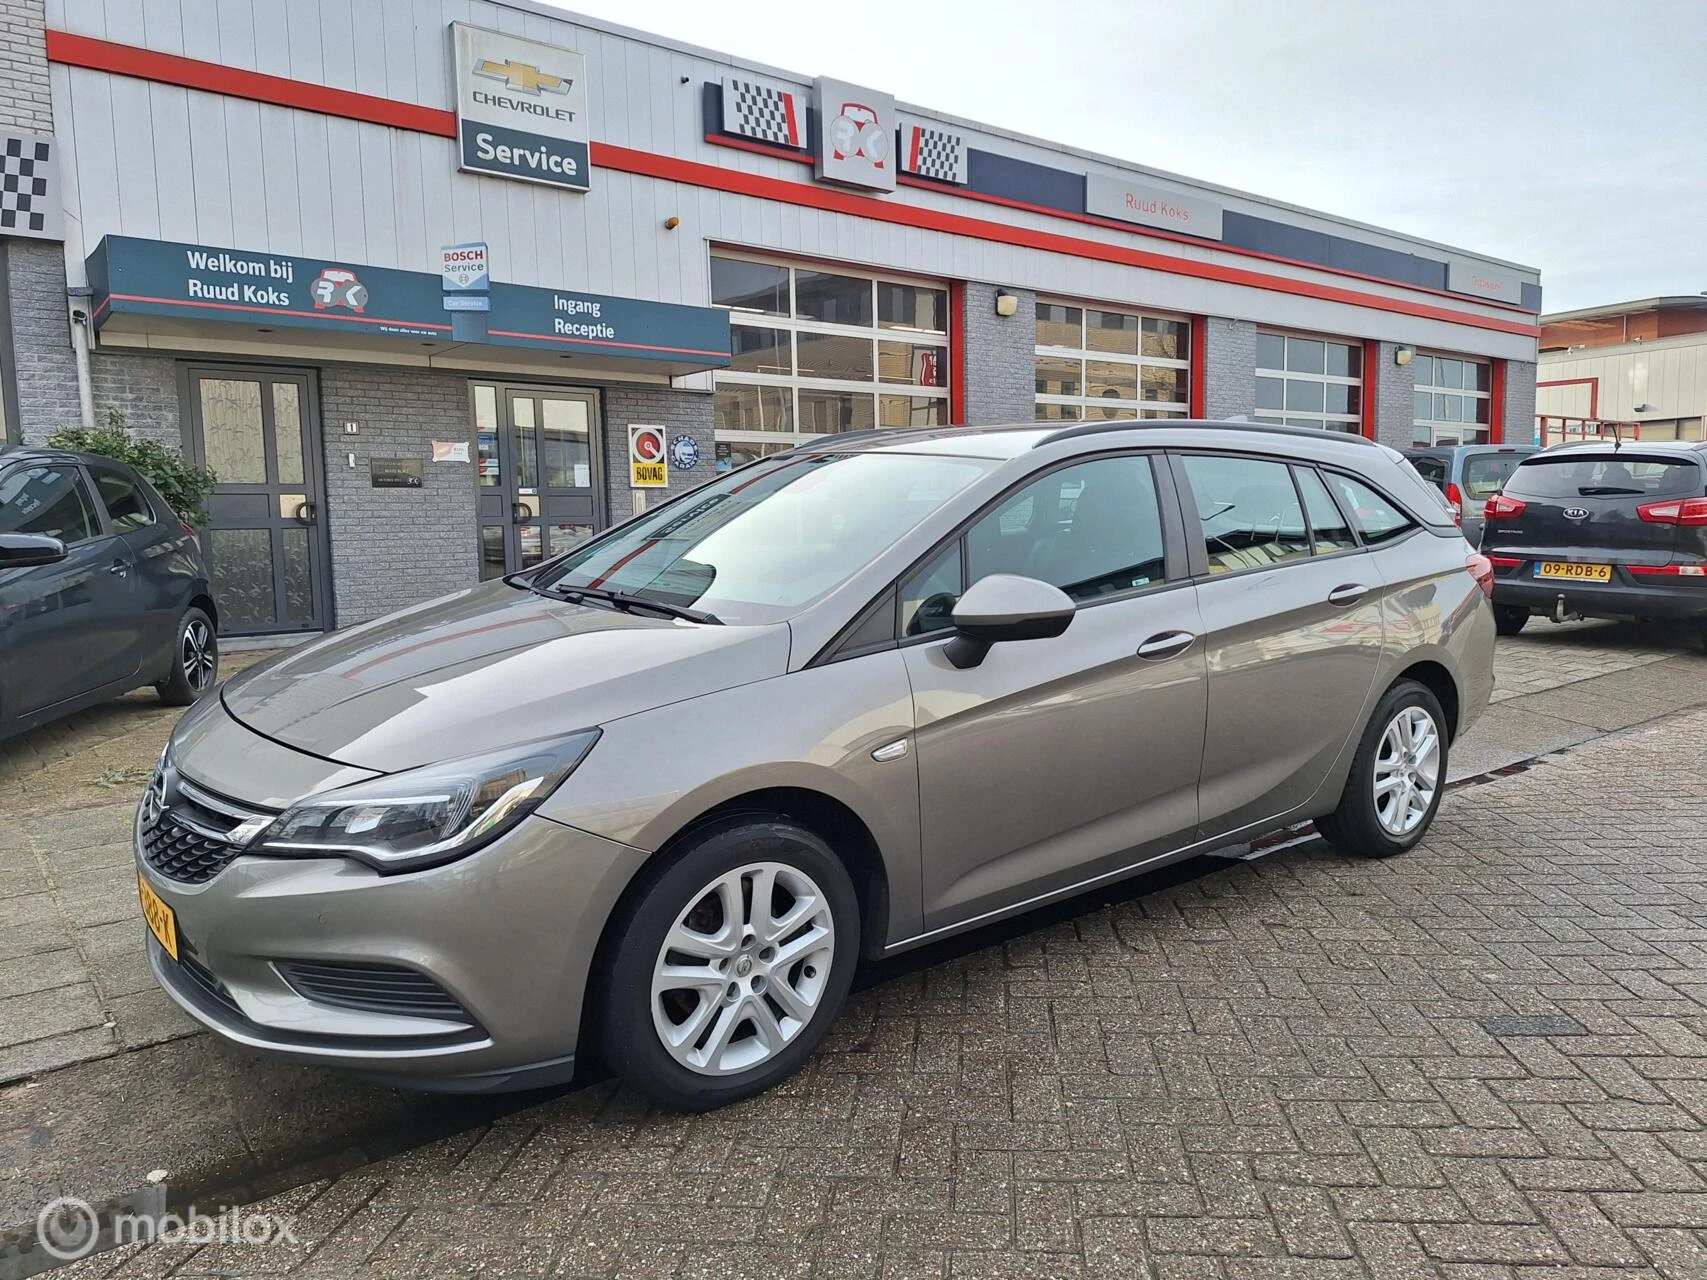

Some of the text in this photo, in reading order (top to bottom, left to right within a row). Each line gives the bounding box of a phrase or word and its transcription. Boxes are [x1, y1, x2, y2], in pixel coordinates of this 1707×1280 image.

[472, 91, 576, 122] CHEVROLET
[476, 132, 577, 176] Service
[1126, 192, 1189, 220] Ruud Koks
[187, 250, 293, 283] Welkom bij
[444, 250, 483, 262] BOSCH
[444, 262, 484, 272] Service
[188, 279, 289, 306] Ruud Koks
[554, 294, 600, 318] Ingang
[554, 318, 614, 340] Receptie
[636, 466, 663, 480] BOVAG
[1543, 563, 1607, 577] 09-RDB-6
